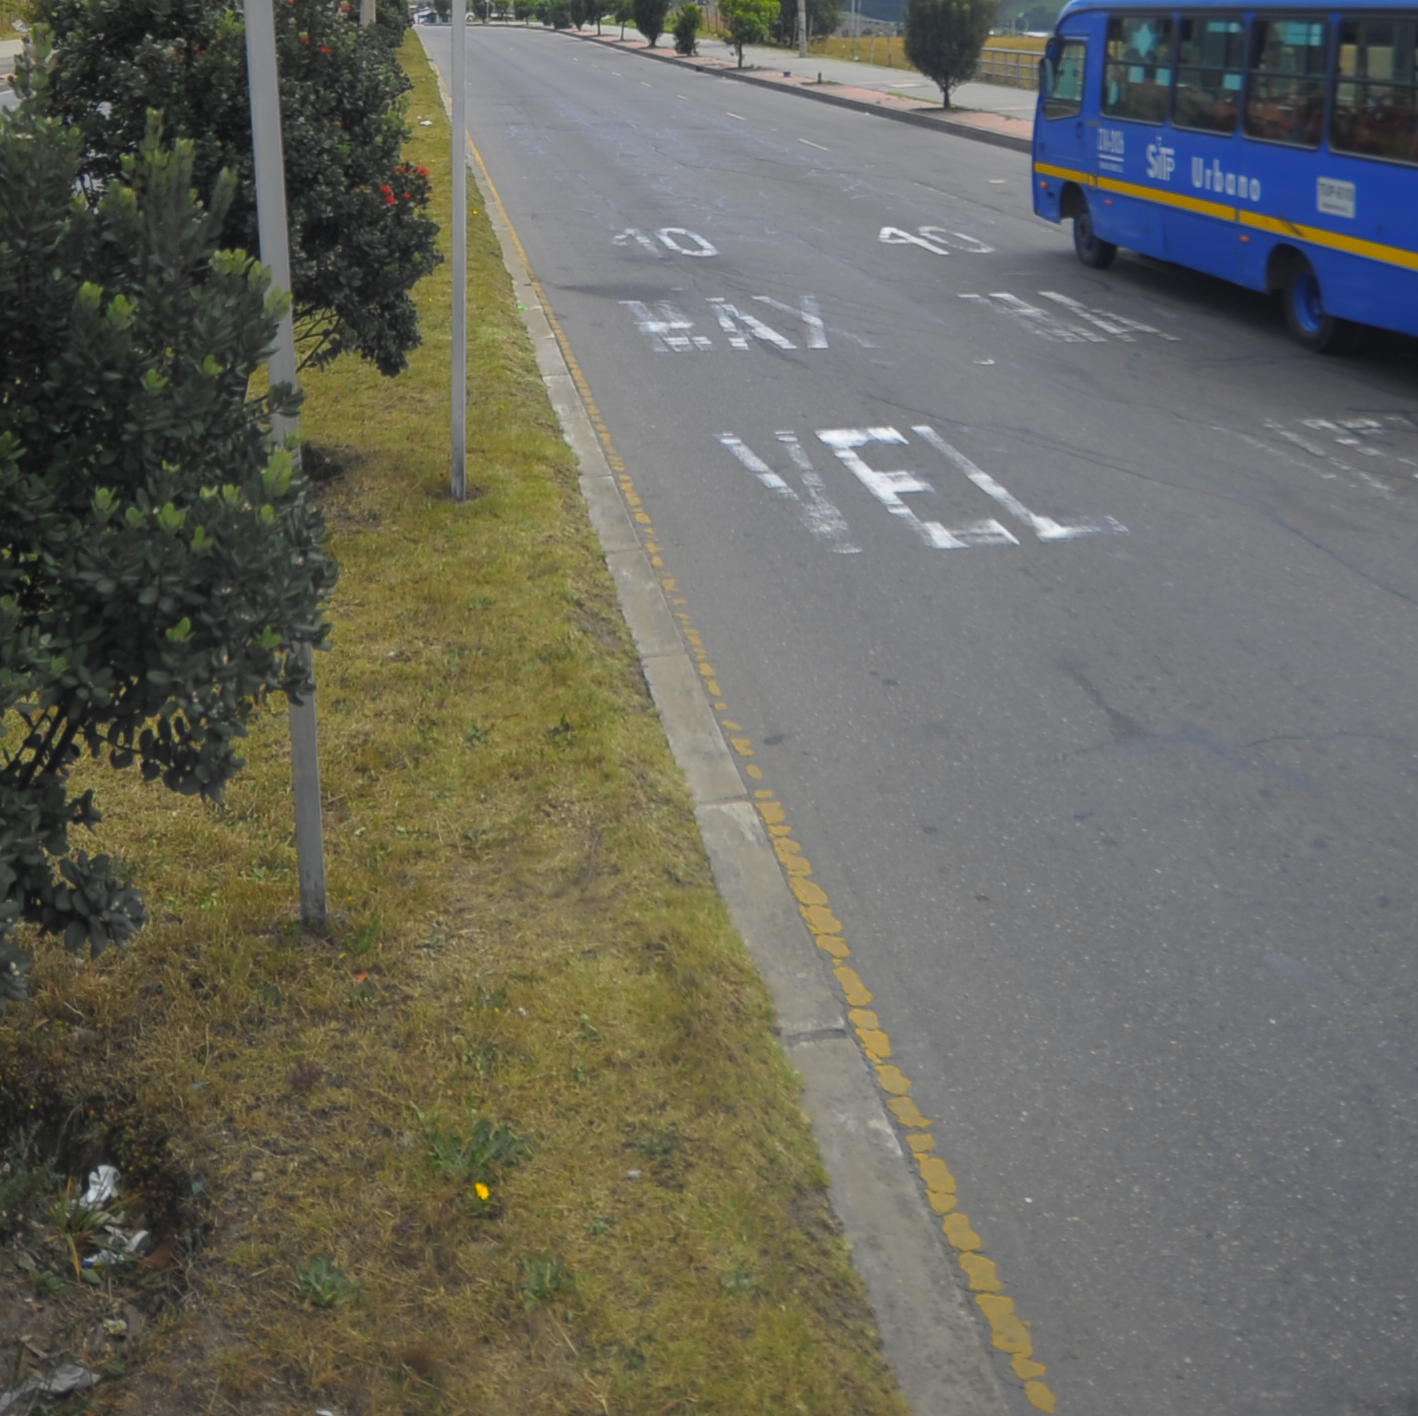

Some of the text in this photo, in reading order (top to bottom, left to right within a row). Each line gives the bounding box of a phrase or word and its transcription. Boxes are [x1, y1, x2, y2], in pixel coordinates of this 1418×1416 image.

[1191, 156, 1261, 202] Urbano
[878, 226, 995, 256] 40
[713, 424, 1130, 554] VEL
